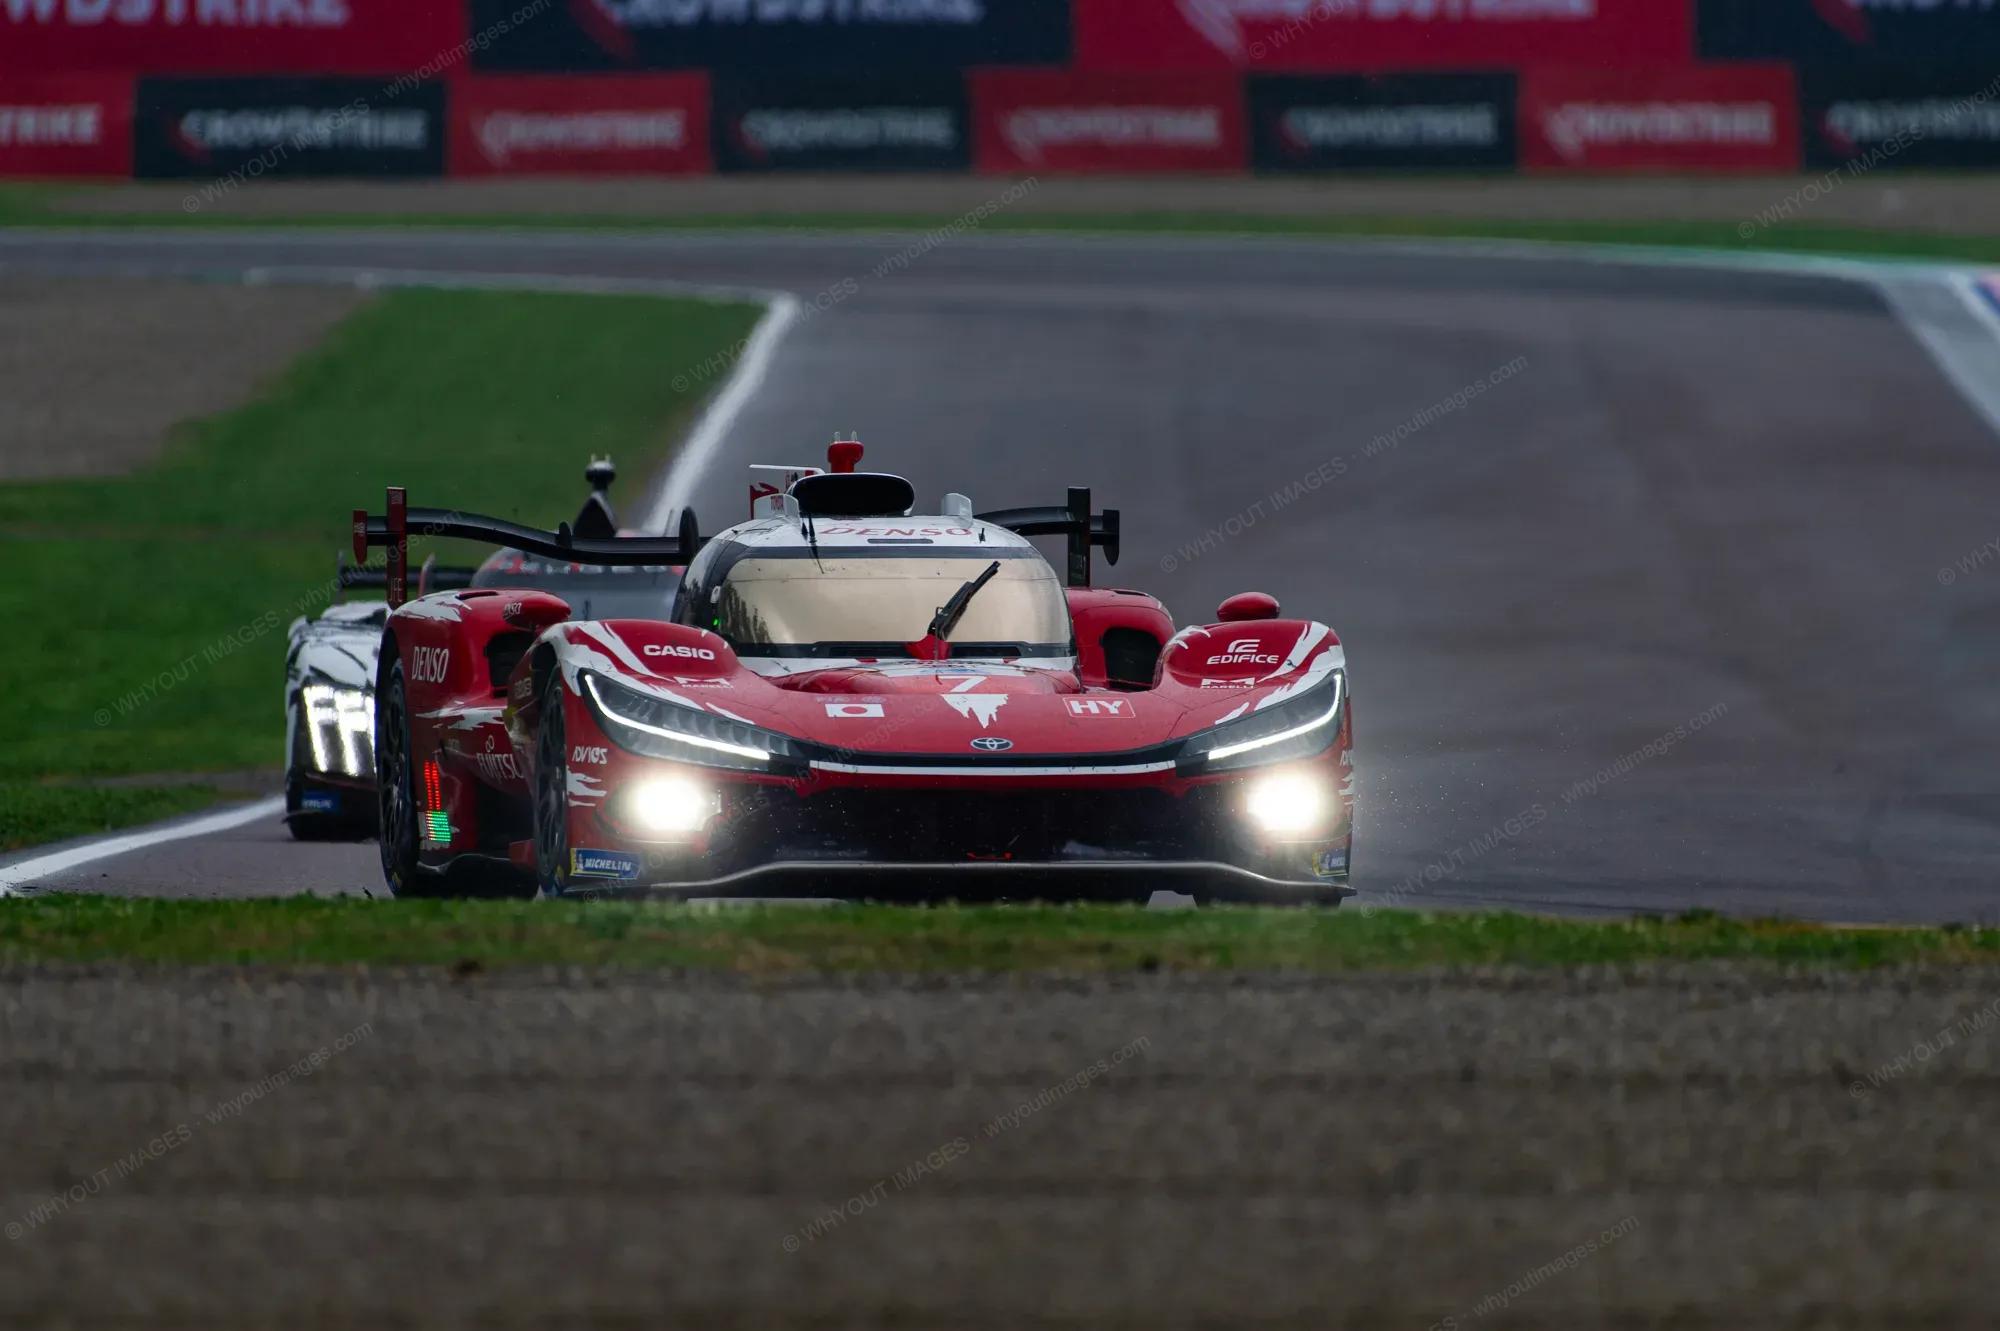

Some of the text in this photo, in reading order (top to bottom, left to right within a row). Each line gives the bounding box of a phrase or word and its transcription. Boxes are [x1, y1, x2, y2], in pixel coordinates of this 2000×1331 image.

[818, 527, 972, 536] DENSO
[643, 644, 715, 661] CASIO
[1206, 654, 1280, 665] EDIFICE
[412, 646, 449, 683] DENSO
[937, 675, 988, 693] 7
[1069, 700, 1123, 714] HY
[584, 858, 632, 871] MICHELIN
